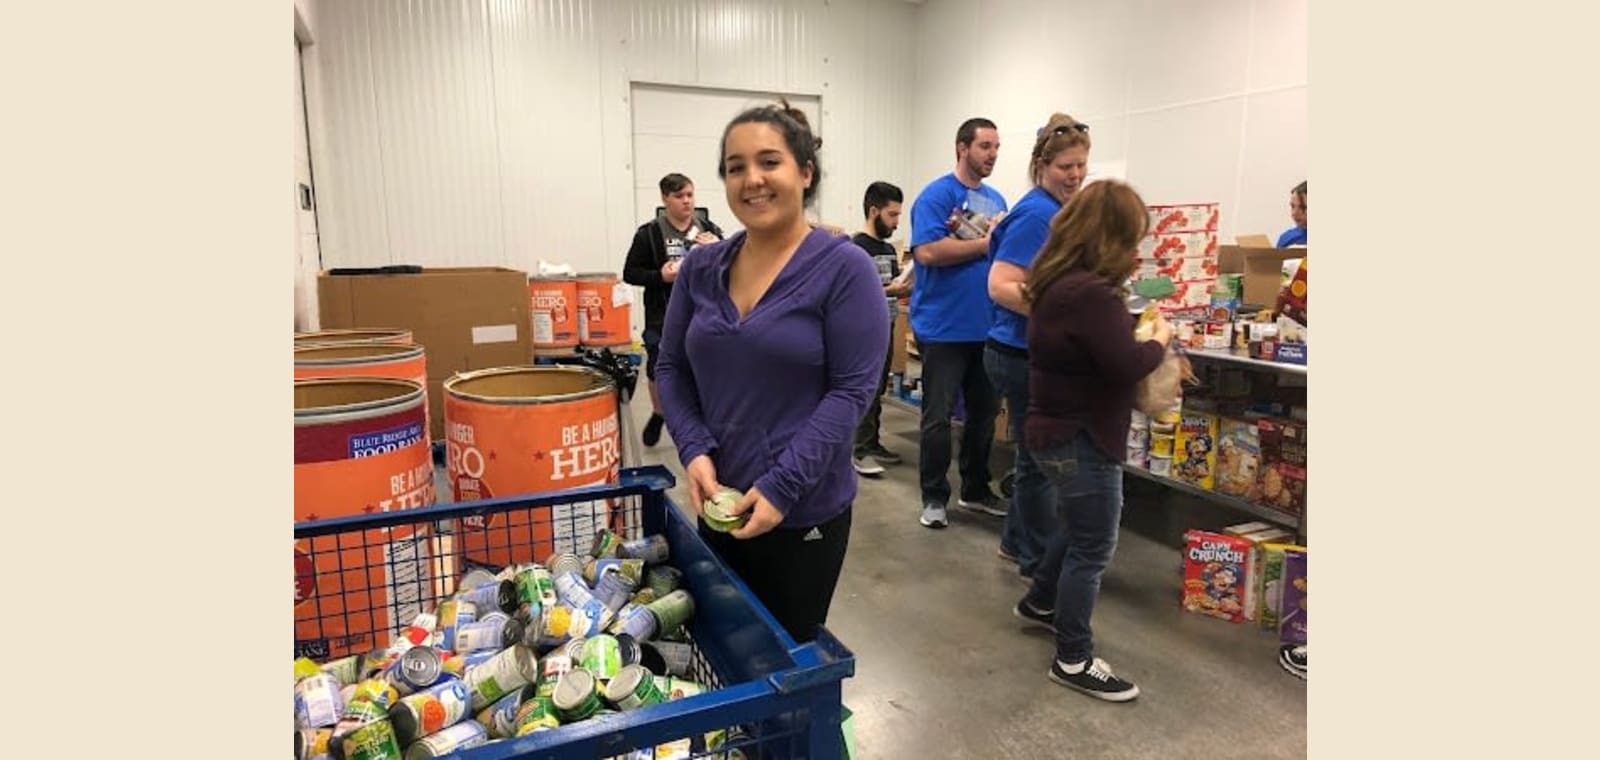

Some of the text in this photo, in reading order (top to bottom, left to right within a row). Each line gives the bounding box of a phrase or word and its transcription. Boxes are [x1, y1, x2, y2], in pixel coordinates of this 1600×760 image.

[353, 437, 381, 450] BLUE
[562, 425, 579, 447] BE
[582, 423, 591, 443] A
[390, 473, 406, 496] BE
[1189, 548, 1244, 564] CRUNCH
